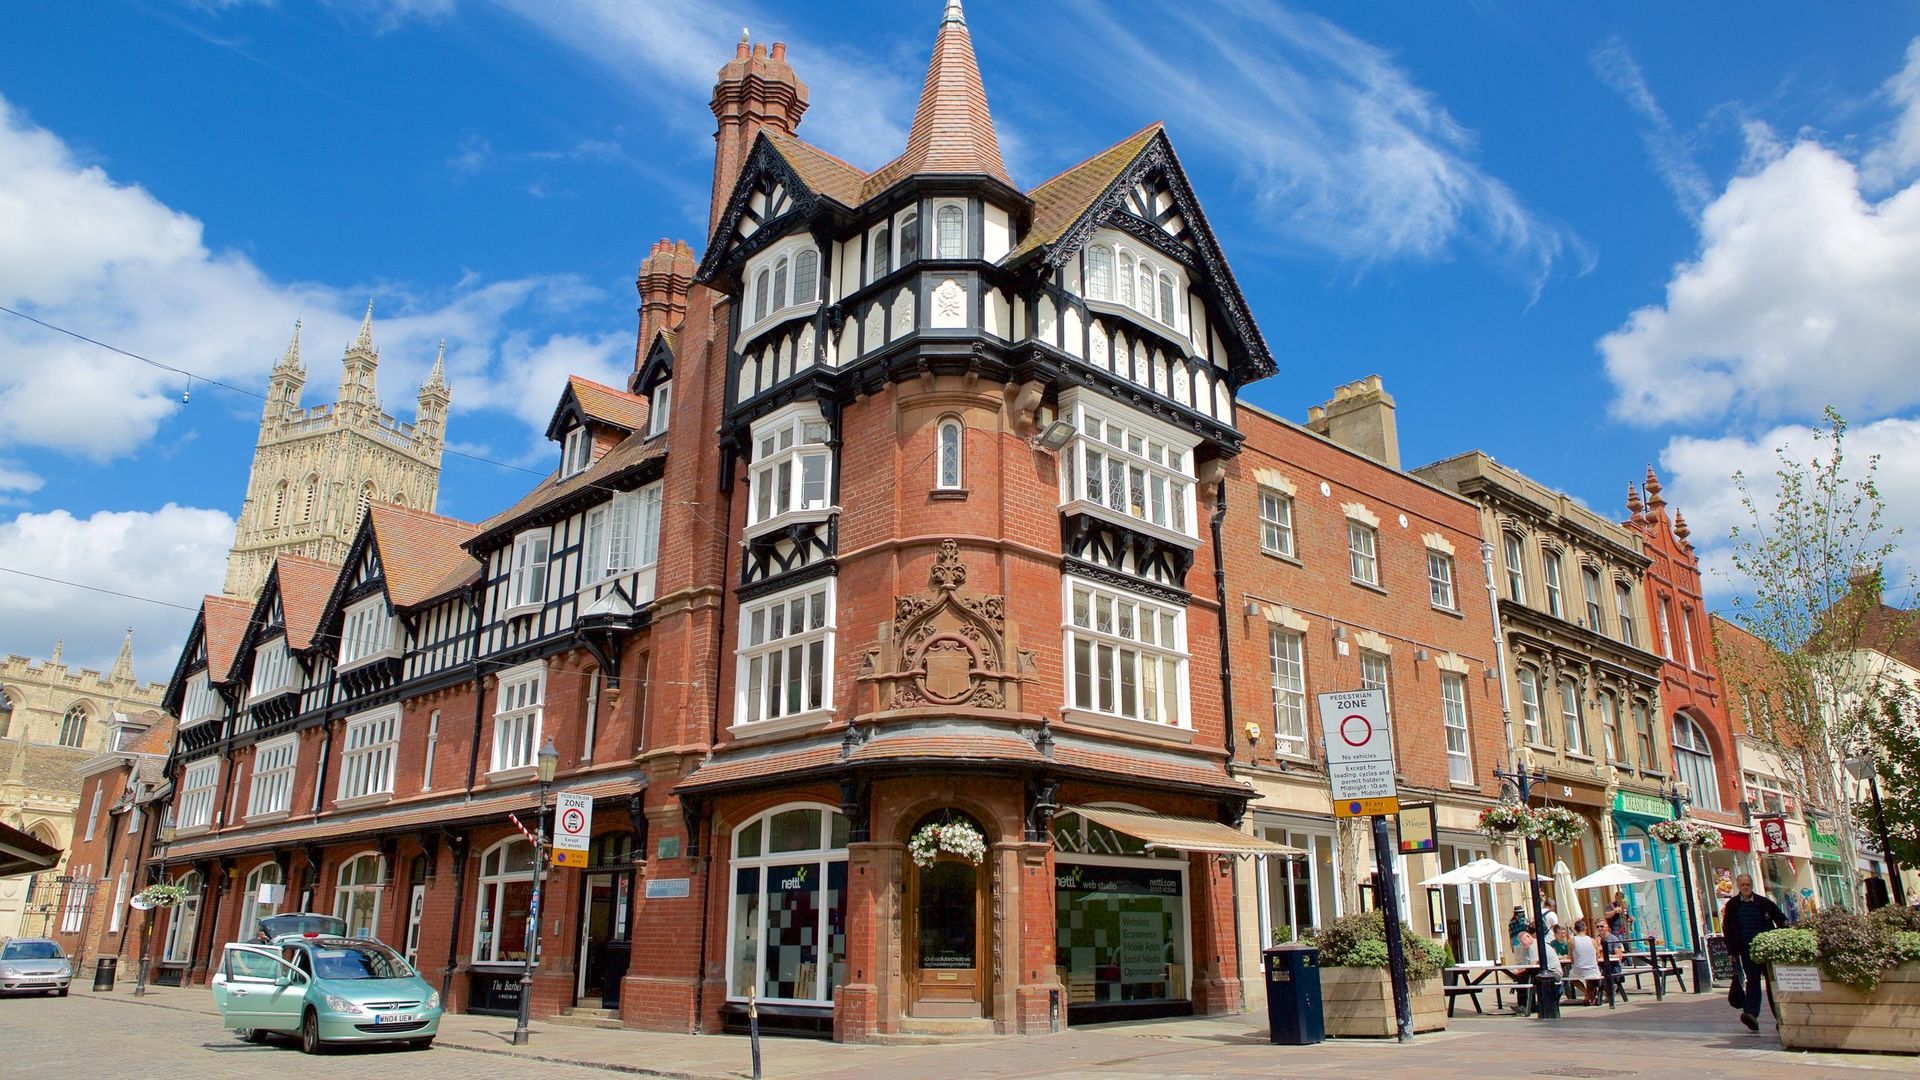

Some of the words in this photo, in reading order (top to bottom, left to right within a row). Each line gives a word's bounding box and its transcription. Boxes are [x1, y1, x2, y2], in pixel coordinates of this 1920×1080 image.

[1330, 692, 1372, 700] PEDESTRIAN
[1337, 699, 1367, 709] ZONE
[565, 799, 585, 808] ZONE
[781, 877, 801, 889] nettl
[1083, 881, 1096, 889] web
[1098, 880, 1117, 890] studio
